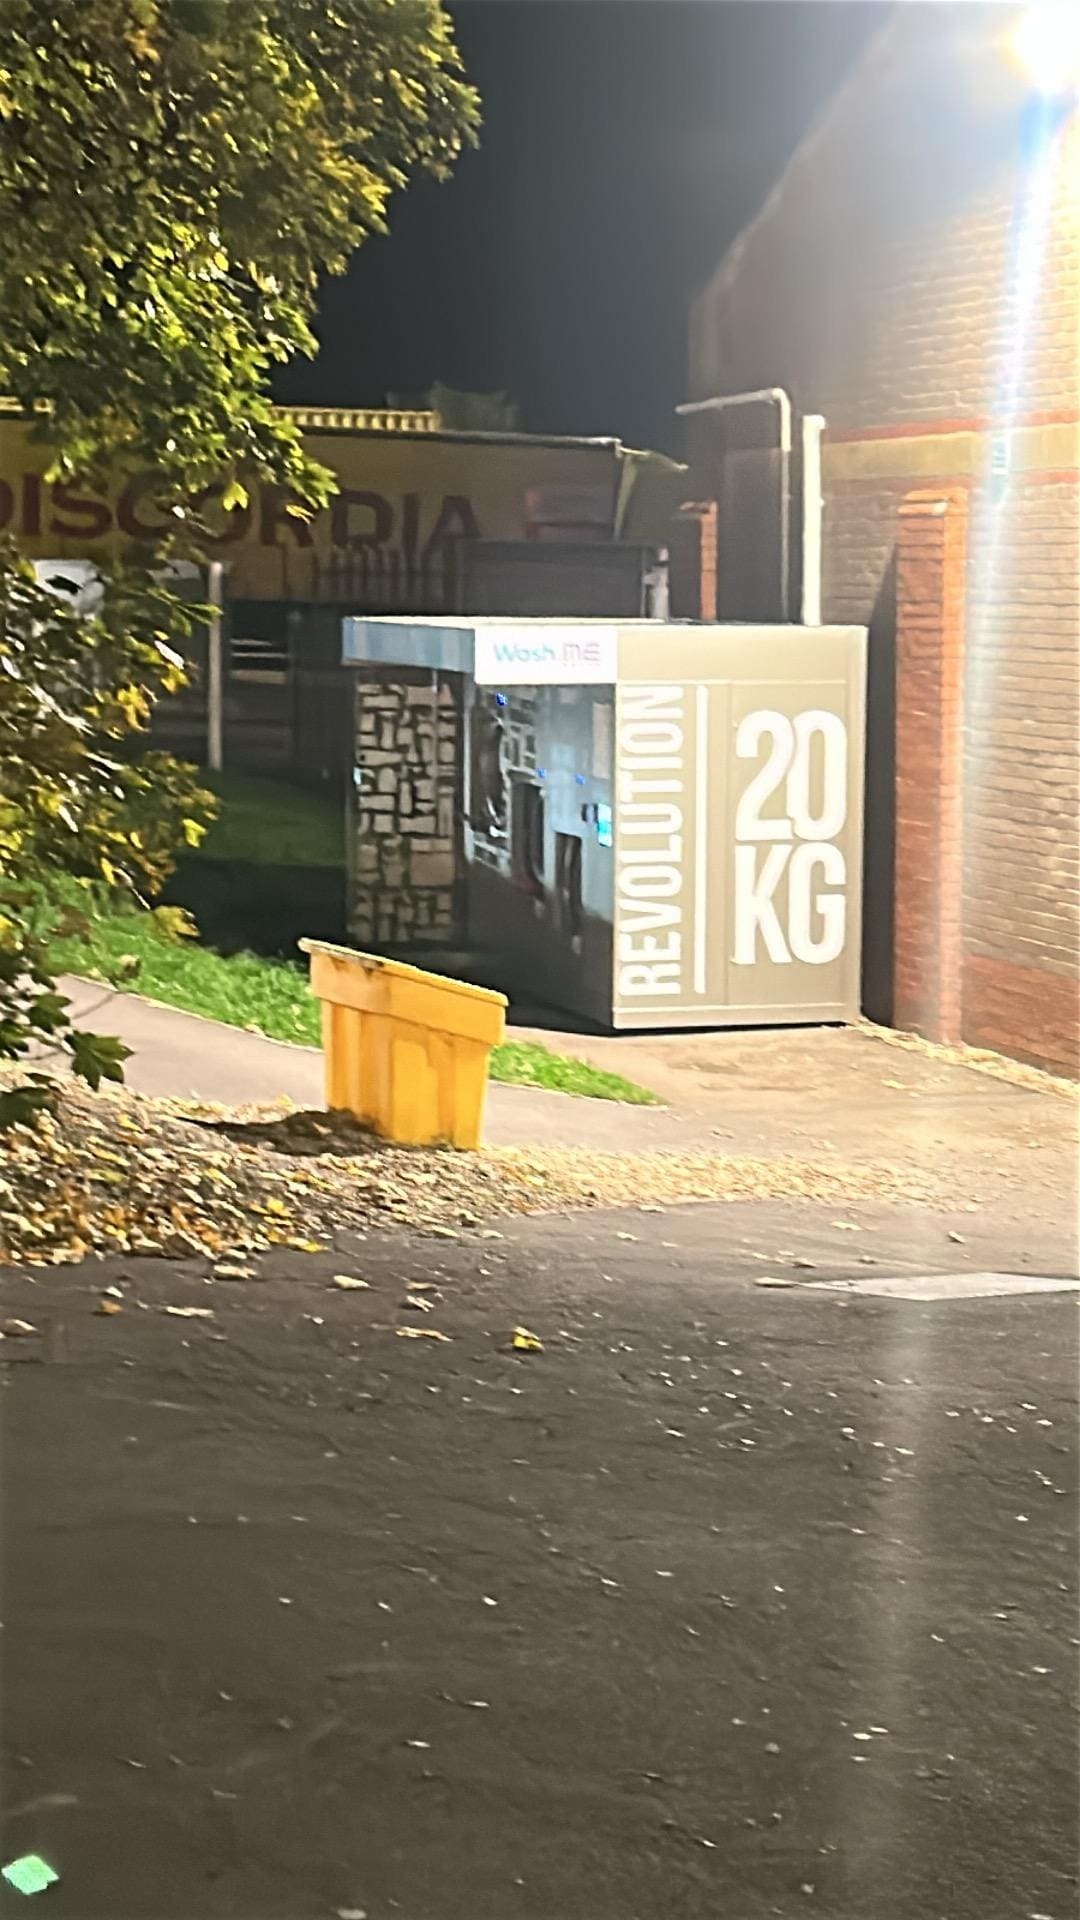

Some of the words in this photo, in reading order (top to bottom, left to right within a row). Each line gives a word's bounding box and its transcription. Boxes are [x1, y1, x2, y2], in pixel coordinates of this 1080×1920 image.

[0, 471, 480, 552] ISCORDIA
[735, 710, 847, 840] 20
[620, 686, 684, 996] REVOLUTION
[733, 842, 847, 964] KG
